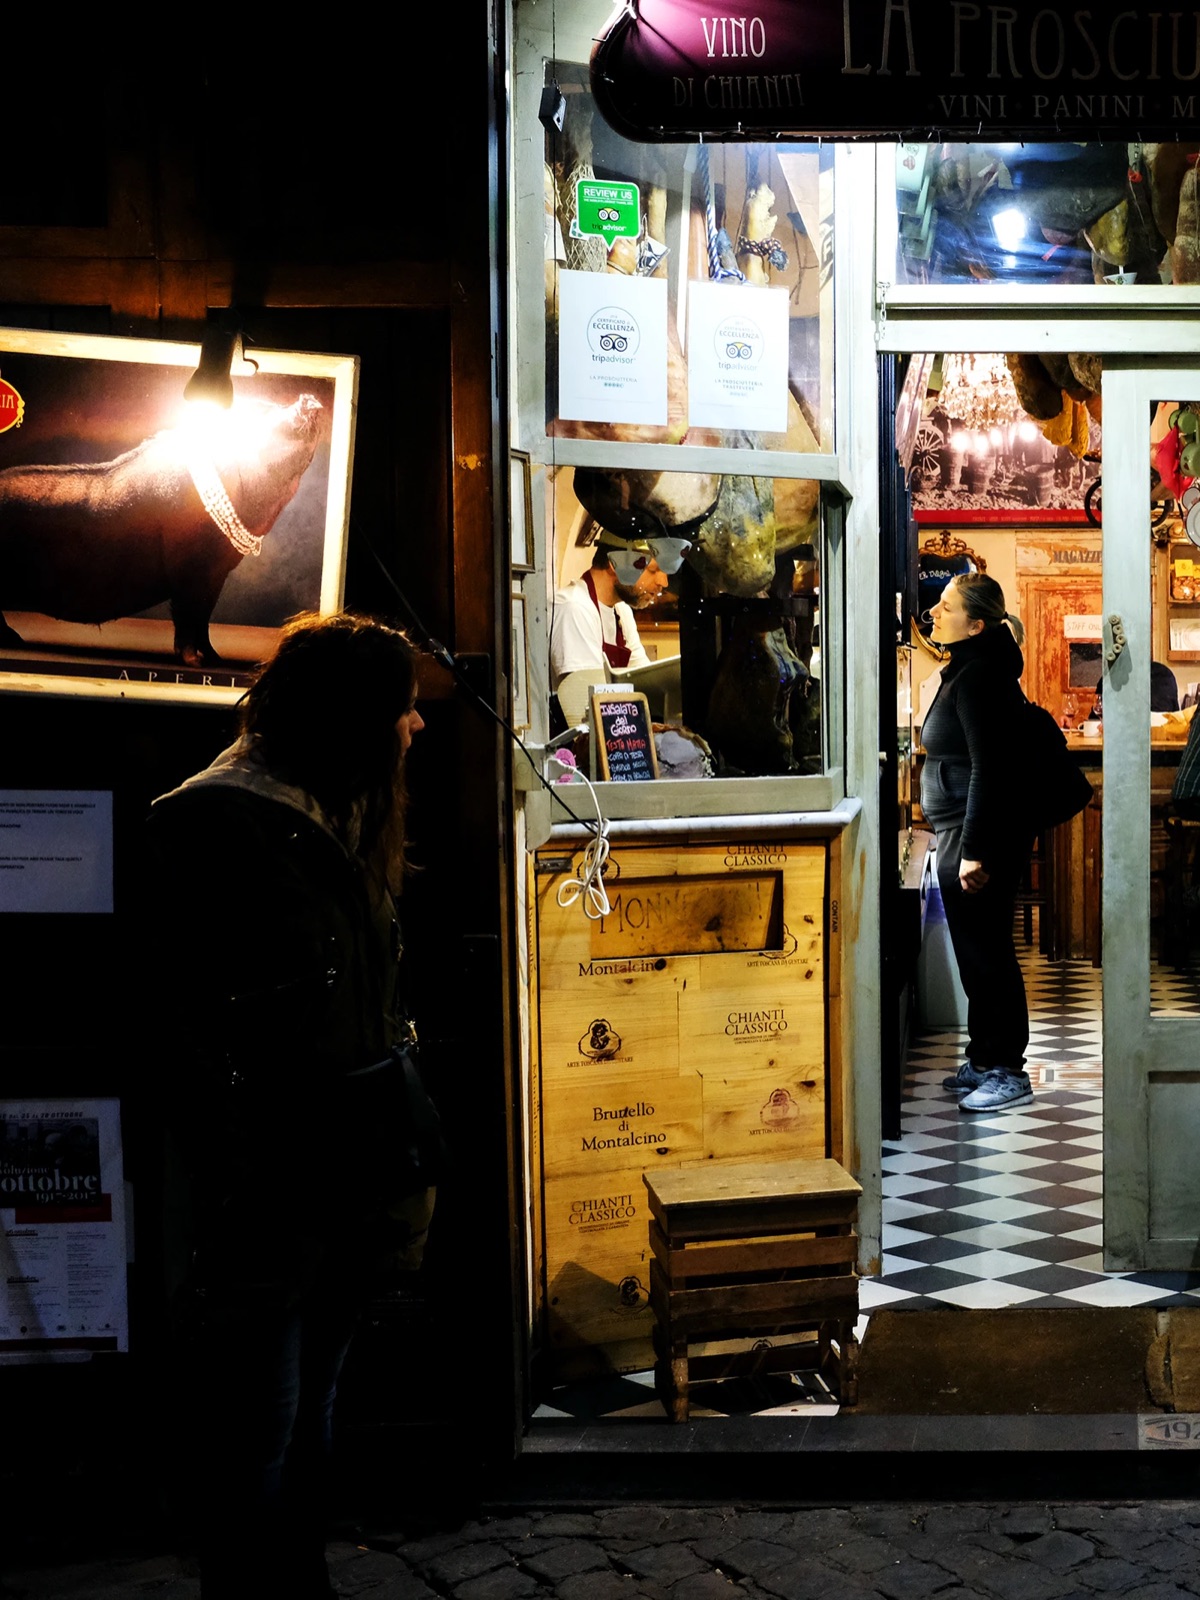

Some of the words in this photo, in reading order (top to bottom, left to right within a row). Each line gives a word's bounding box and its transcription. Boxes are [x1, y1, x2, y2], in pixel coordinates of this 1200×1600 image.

[701, 16, 767, 58] VINO
[841, 0, 921, 77] LA
[673, 76, 695, 108] DI
[704, 72, 806, 110] CHIANTI
[939, 94, 1007, 118] VINI
[1033, 95, 1145, 119] PANINI
[583, 188, 618, 199] REVIEW
[621, 191, 633, 200] US
[592, 223, 627, 231] tripadvisor
[592, 322, 635, 332] ECCELLENZA
[719, 330, 760, 339] ECCELLENZA
[592, 353, 636, 364] tripadvisor
[718, 361, 758, 371] tripadvisor
[0, 395, 14, 408] IA
[1066, 622, 1086, 632] STAFF
[118, 669, 236, 687] APERI
[727, 844, 784, 855] CHIANTI
[724, 853, 787, 867] CLASSICO
[579, 959, 666, 977] Montalcin
[728, 1009, 784, 1024] CHIANTI
[725, 1020, 788, 1036] CLASSICO
[593, 1101, 655, 1122] Brunello
[618, 1120, 629, 1132] di
[581, 1131, 667, 1152] Montalcino
[1, 1168, 97, 1193] ottobre
[36, 1191, 96, 1203] 1917-2017
[571, 1195, 632, 1213] CHIANTI
[568, 1206, 636, 1225] CLASSICO
